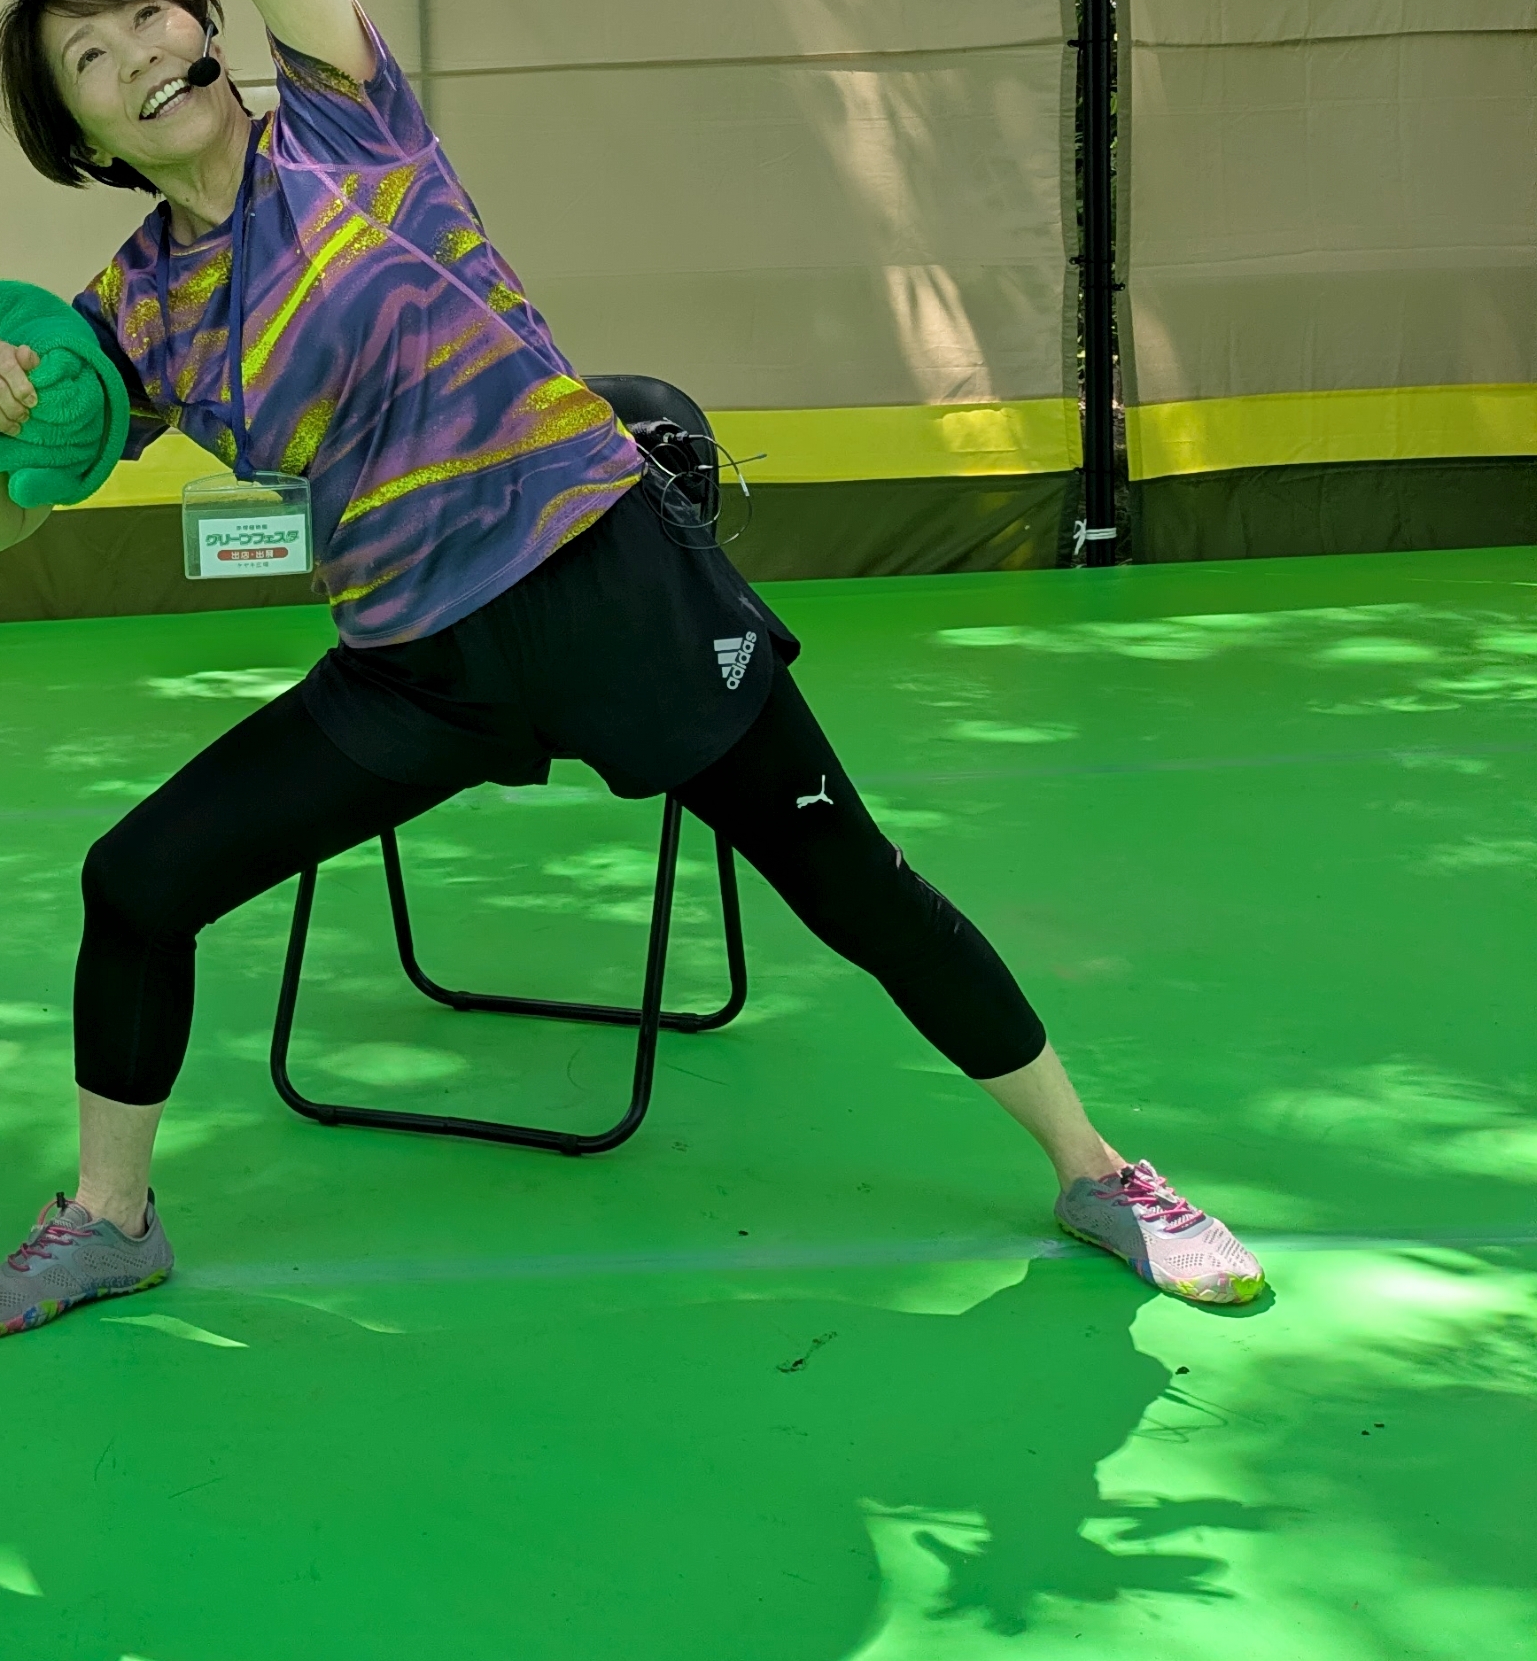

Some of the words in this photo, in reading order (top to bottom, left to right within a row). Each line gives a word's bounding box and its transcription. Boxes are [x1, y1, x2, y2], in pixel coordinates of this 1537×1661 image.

[205, 530, 300, 547] グリーンフェスタ
[726, 631, 757, 690] adidas
